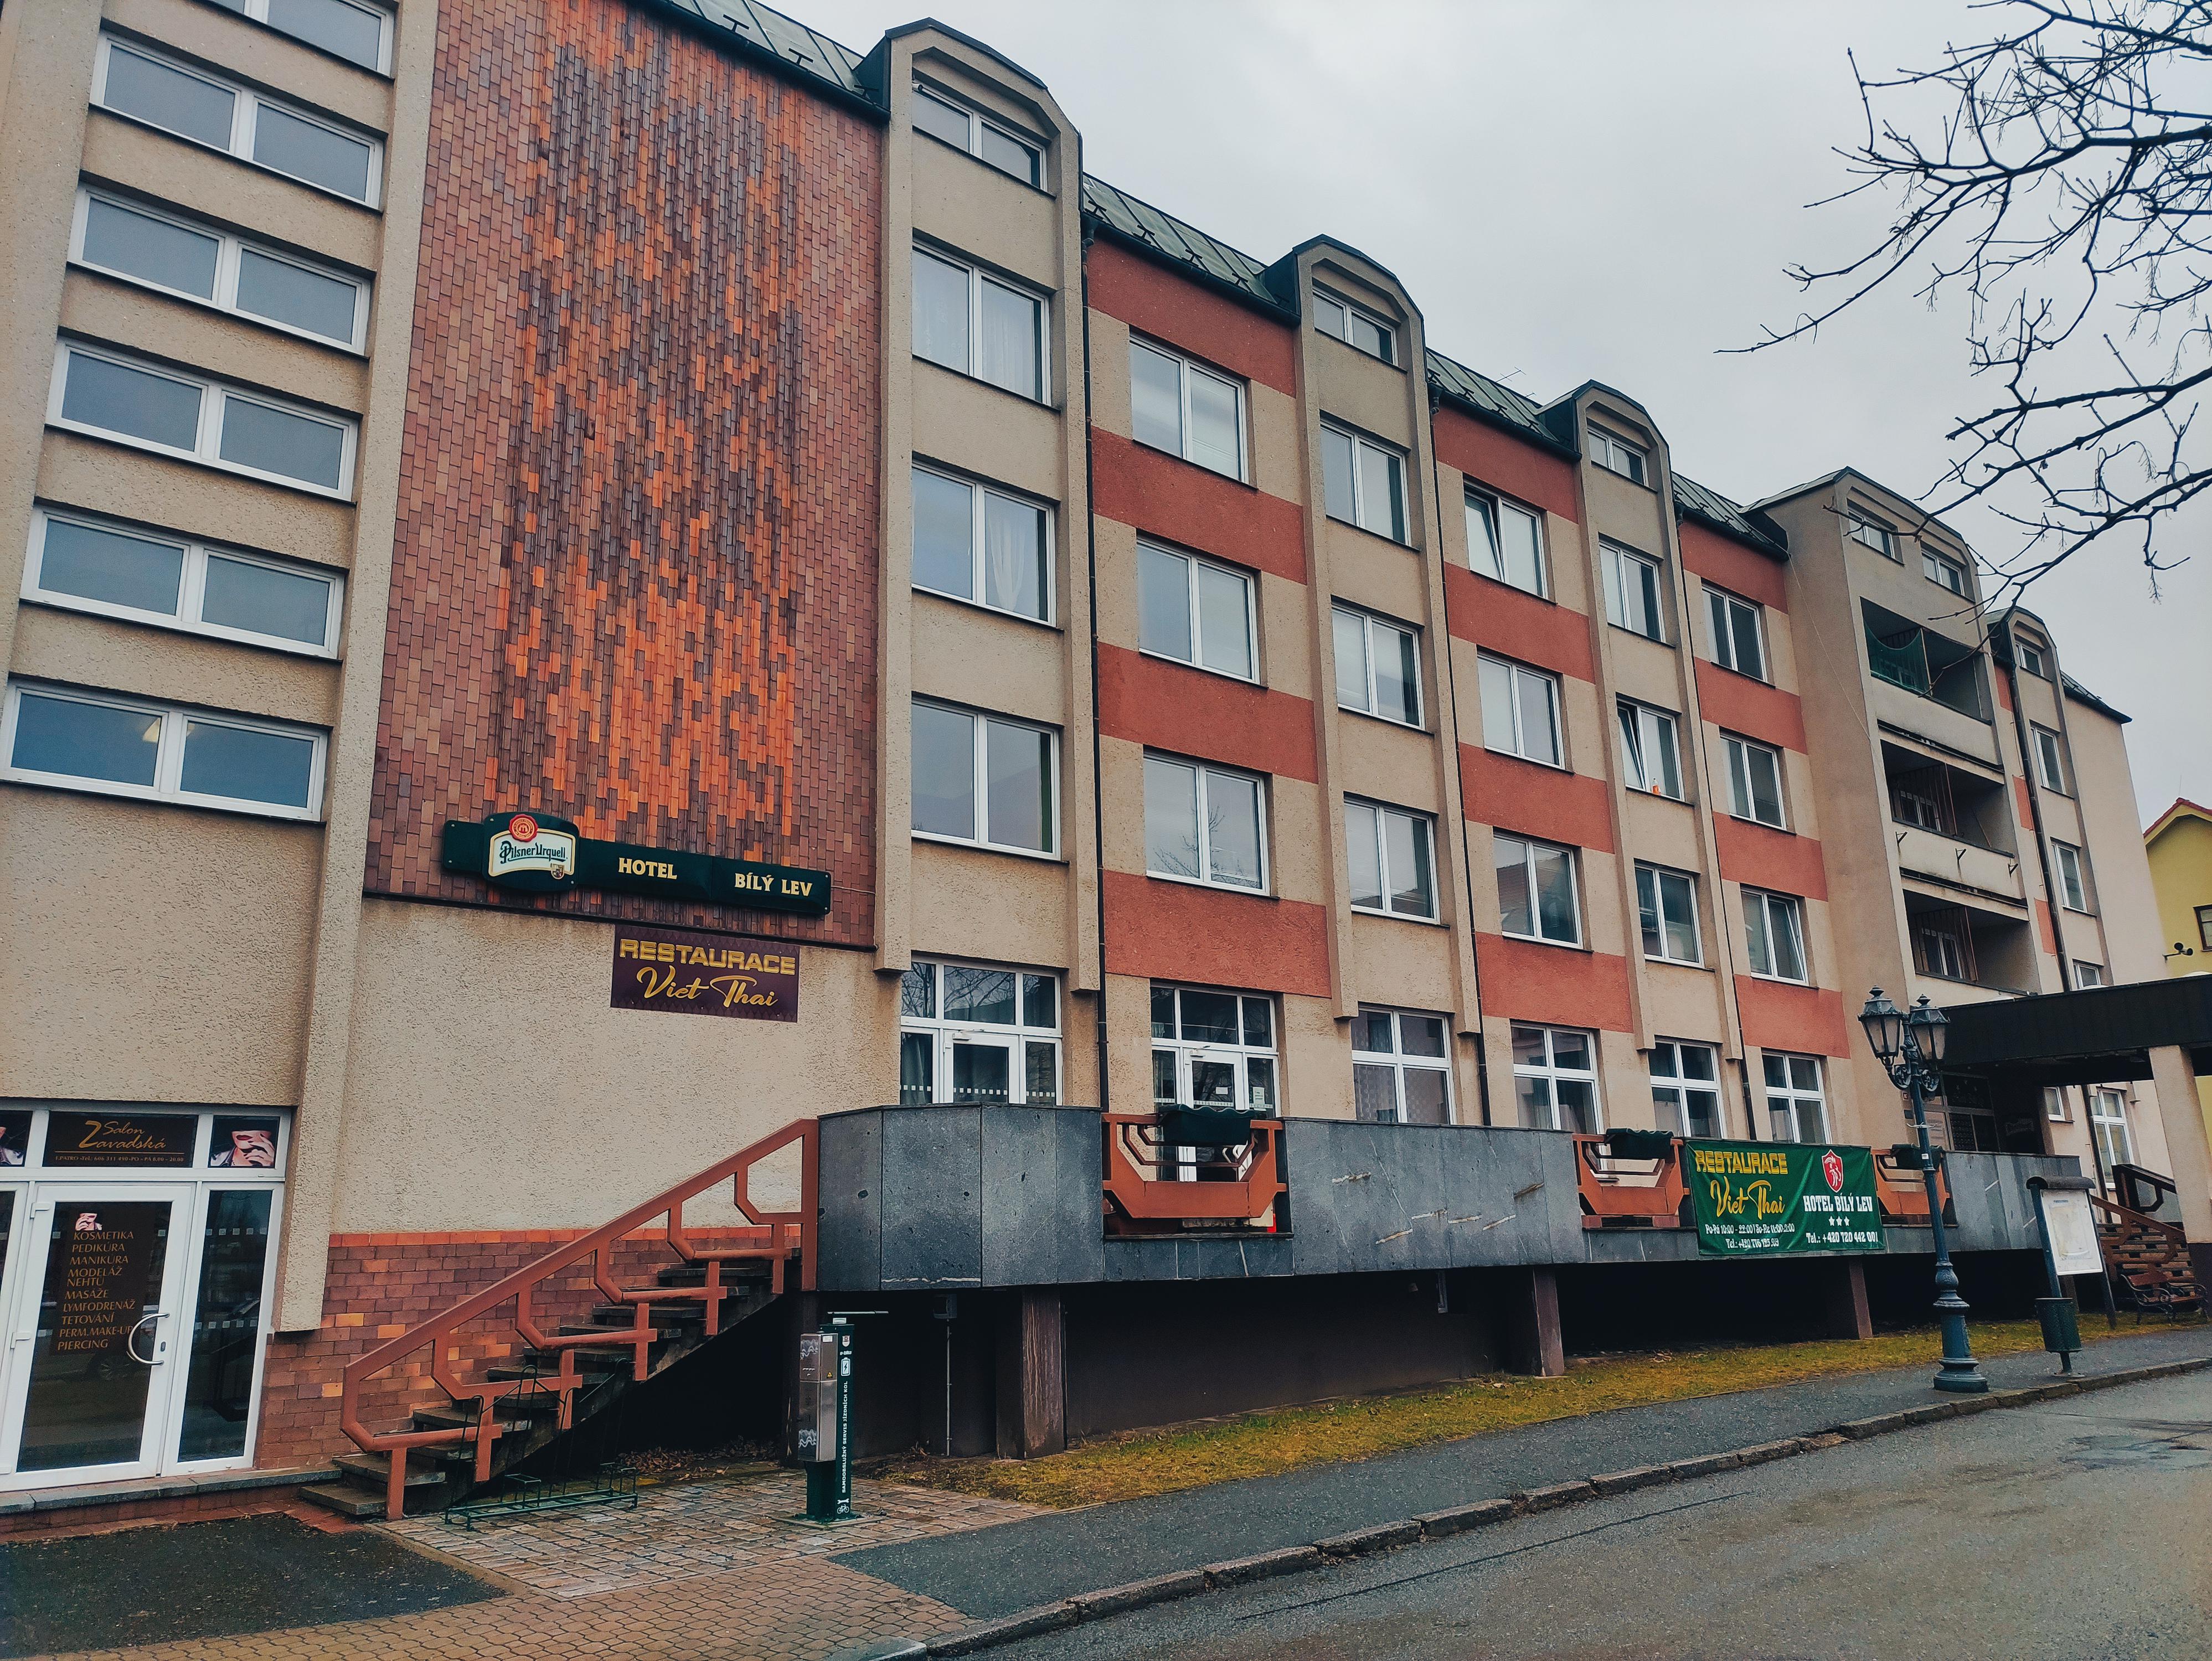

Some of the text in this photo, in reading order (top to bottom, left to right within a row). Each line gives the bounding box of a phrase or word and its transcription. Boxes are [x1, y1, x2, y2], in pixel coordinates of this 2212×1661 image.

[499, 840, 535, 864] Pilsner
[618, 857, 813, 897] HOTEL BÍLÝ LEV
[620, 938, 796, 976] RESTAURACE
[636, 966, 778, 1008] Viet Thai
[79, 1120, 166, 1149] Zavadská
[103, 1121, 145, 1135] Salon
[1694, 1151, 1788, 1174] RESTAURACE
[1710, 1175, 1786, 1220] Viet Thai
[1803, 1192, 1873, 1212] HOTEL BÍLÝ LEV
[74, 1231, 134, 1240] KOSMETIKA
[1805, 1232, 1821, 1244] Tel.:
[1840, 1231, 1853, 1242] 720
[1866, 1231, 1878, 1242] 001
[68, 1266, 123, 1277] MODELÁŽ
[62, 1312, 115, 1325] TETOVÁNÍ
[58, 1339, 109, 1350] PIERCING
